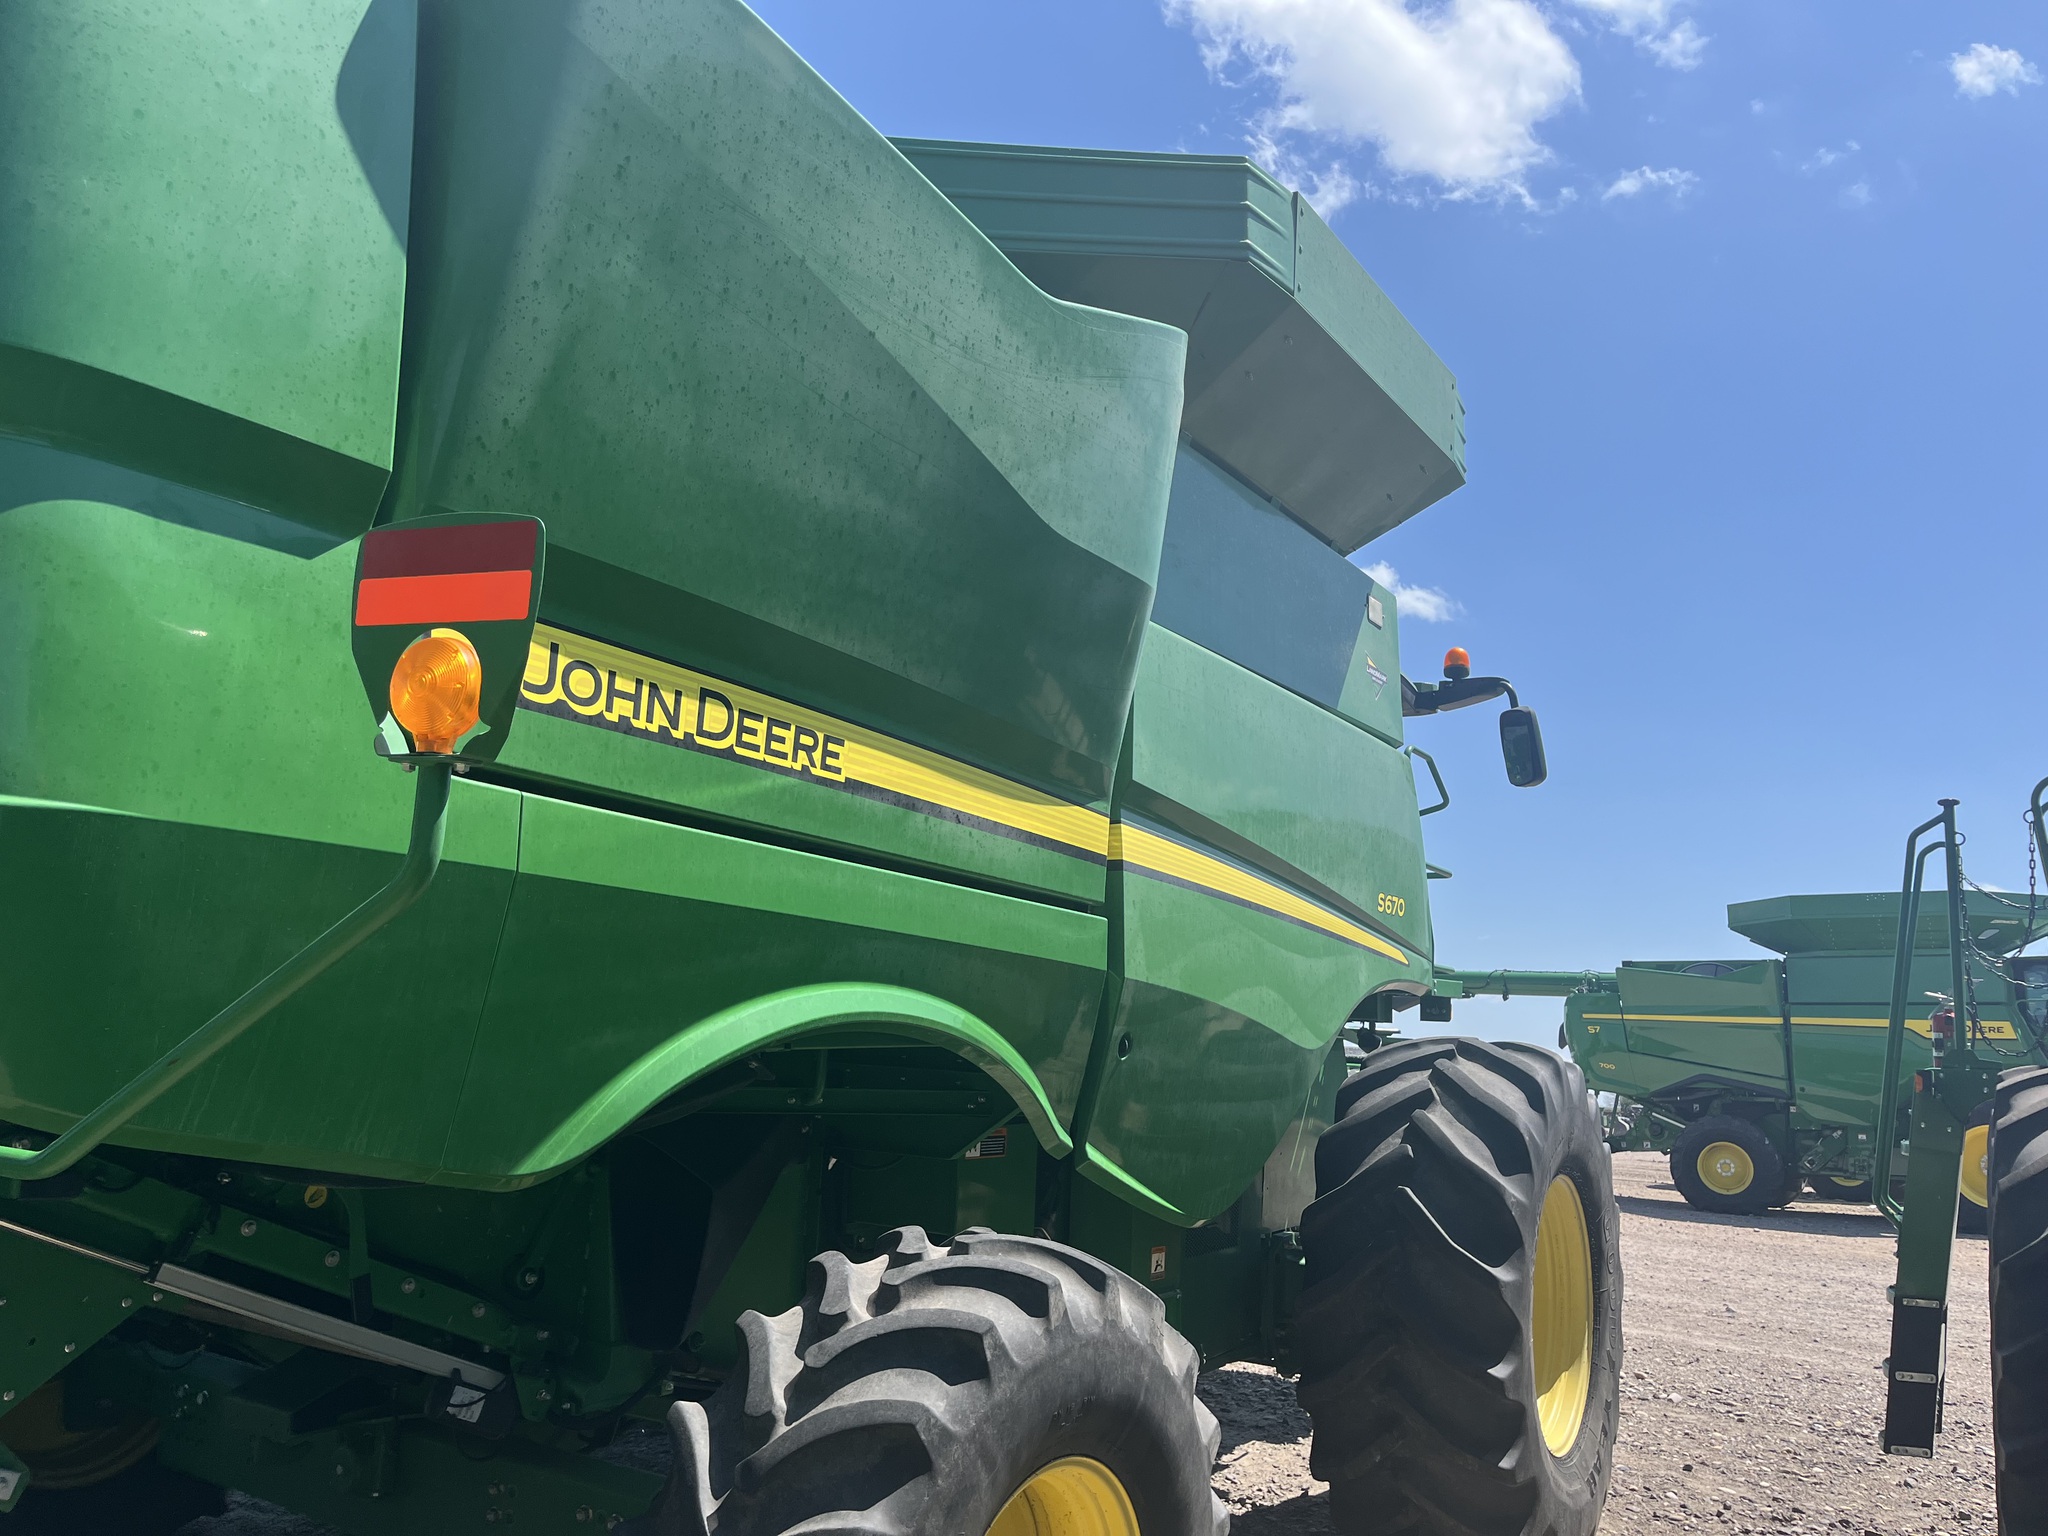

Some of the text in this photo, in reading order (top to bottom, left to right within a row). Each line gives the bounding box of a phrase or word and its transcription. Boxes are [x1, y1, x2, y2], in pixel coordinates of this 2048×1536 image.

[523, 642, 846, 776] JOHN DEERE
[1377, 892, 1405, 917] S670
[1587, 1025, 1600, 1034] S7
[1598, 1062, 1616, 1070] 700
